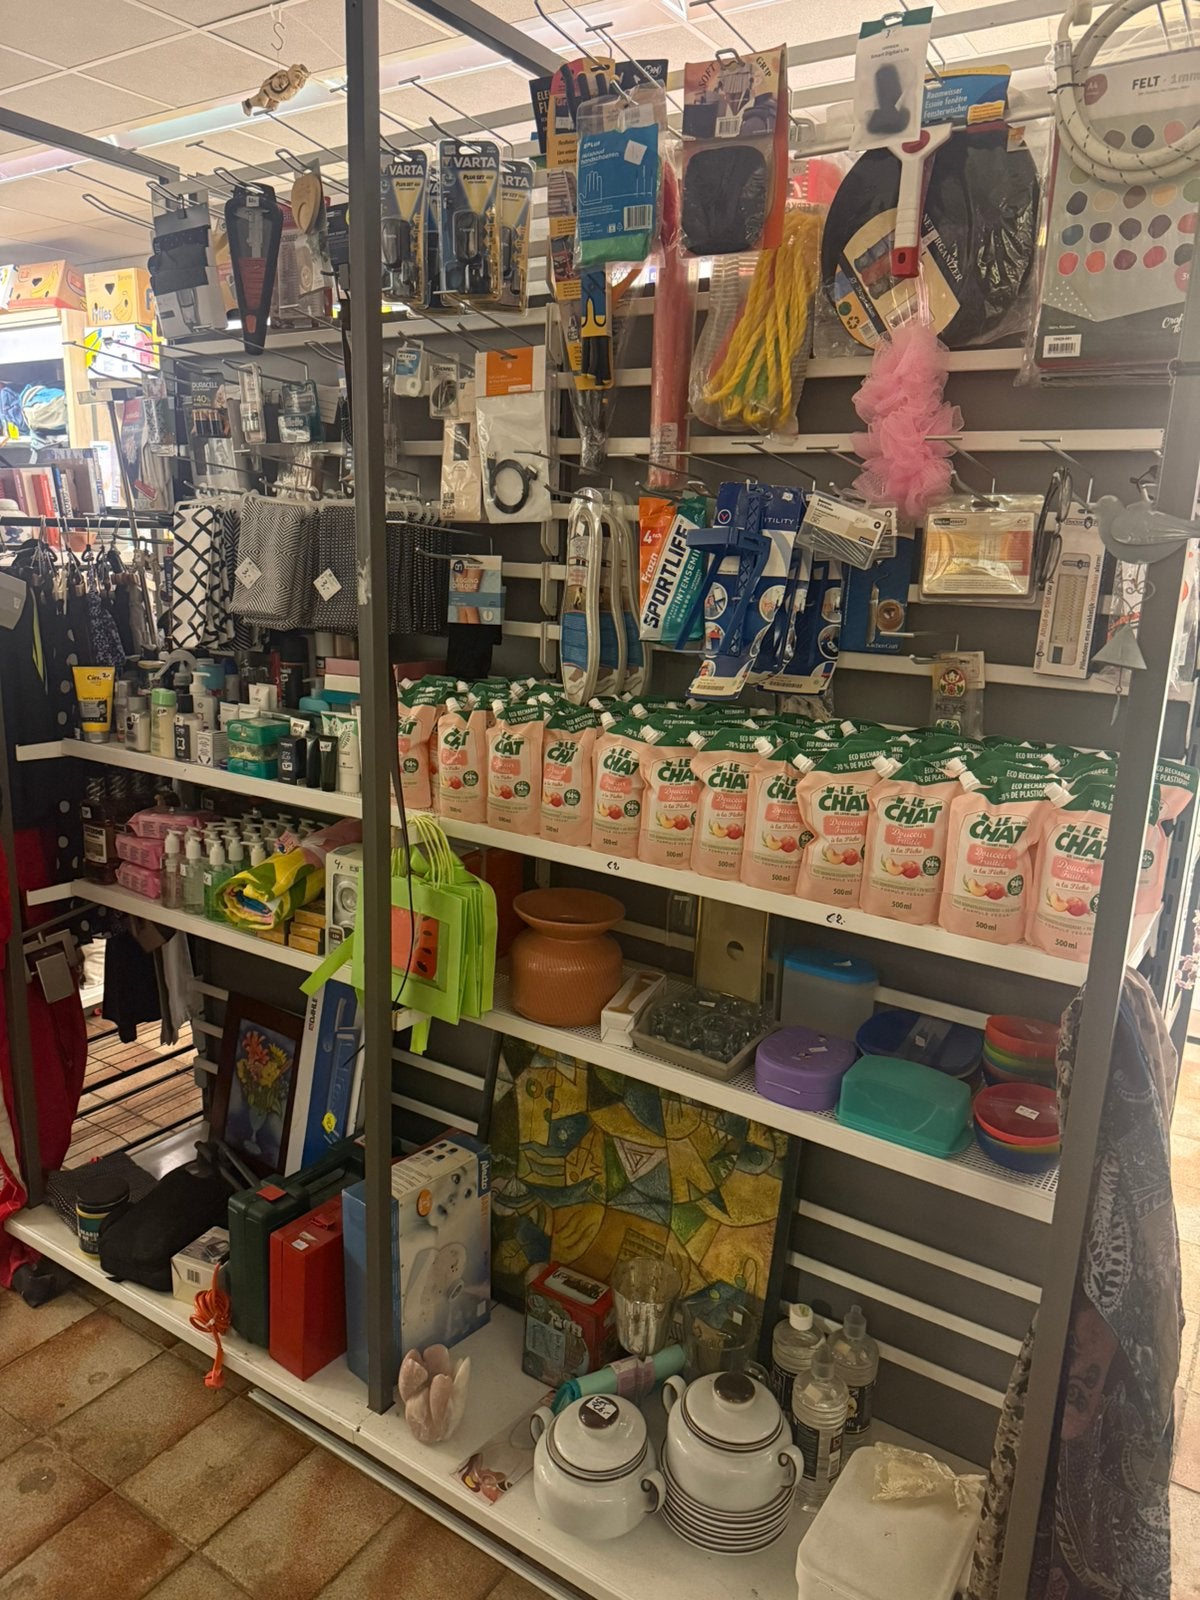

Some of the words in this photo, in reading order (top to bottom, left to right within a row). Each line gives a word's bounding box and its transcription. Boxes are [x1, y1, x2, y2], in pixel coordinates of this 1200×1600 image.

[756, 56, 772, 78] GRIP
[699, 63, 717, 90] SOFT
[1132, 76, 1161, 91] FELT
[452, 156, 498, 169] VARTA
[388, 164, 425, 177] VARTA
[934, 236, 963, 284] RGANIZER
[763, 517, 794, 528] ITILITY
[643, 525, 689, 630] SPORTLIFE
[935, 702, 967, 714] KEYS
[565, 741, 577, 751] LE
[620, 748, 633, 759] LE
[848, 752, 859, 762] ECO
[859, 750, 887, 760] RECHARGE
[679, 757, 692, 768] LE
[729, 763, 741, 774] LE
[785, 777, 799, 787] LE
[1010, 782, 1022, 791] ECO
[840, 786, 854, 796] LE
[910, 797, 925, 808] LE
[883, 805, 943, 827] CHAT
[1000, 816, 1014, 829] LE
[891, 828, 927, 842] Douceur
[968, 819, 1028, 845] CHAT
[1084, 825, 1103, 843] LE
[666, 851, 685, 860] 500ml
[973, 847, 1013, 863] Douceur
[717, 859, 737, 868] 500ml
[925, 860, 939, 869] 94%
[1056, 859, 1096, 876] Douceur
[771, 873, 791, 882] 500ml
[1010, 879, 1023, 890] 94%
[832, 887, 853, 899] 500ml
[891, 901, 912, 912] 500ml
[975, 920, 998, 933] 500ml
[1054, 932, 1078, 946] 500ml
